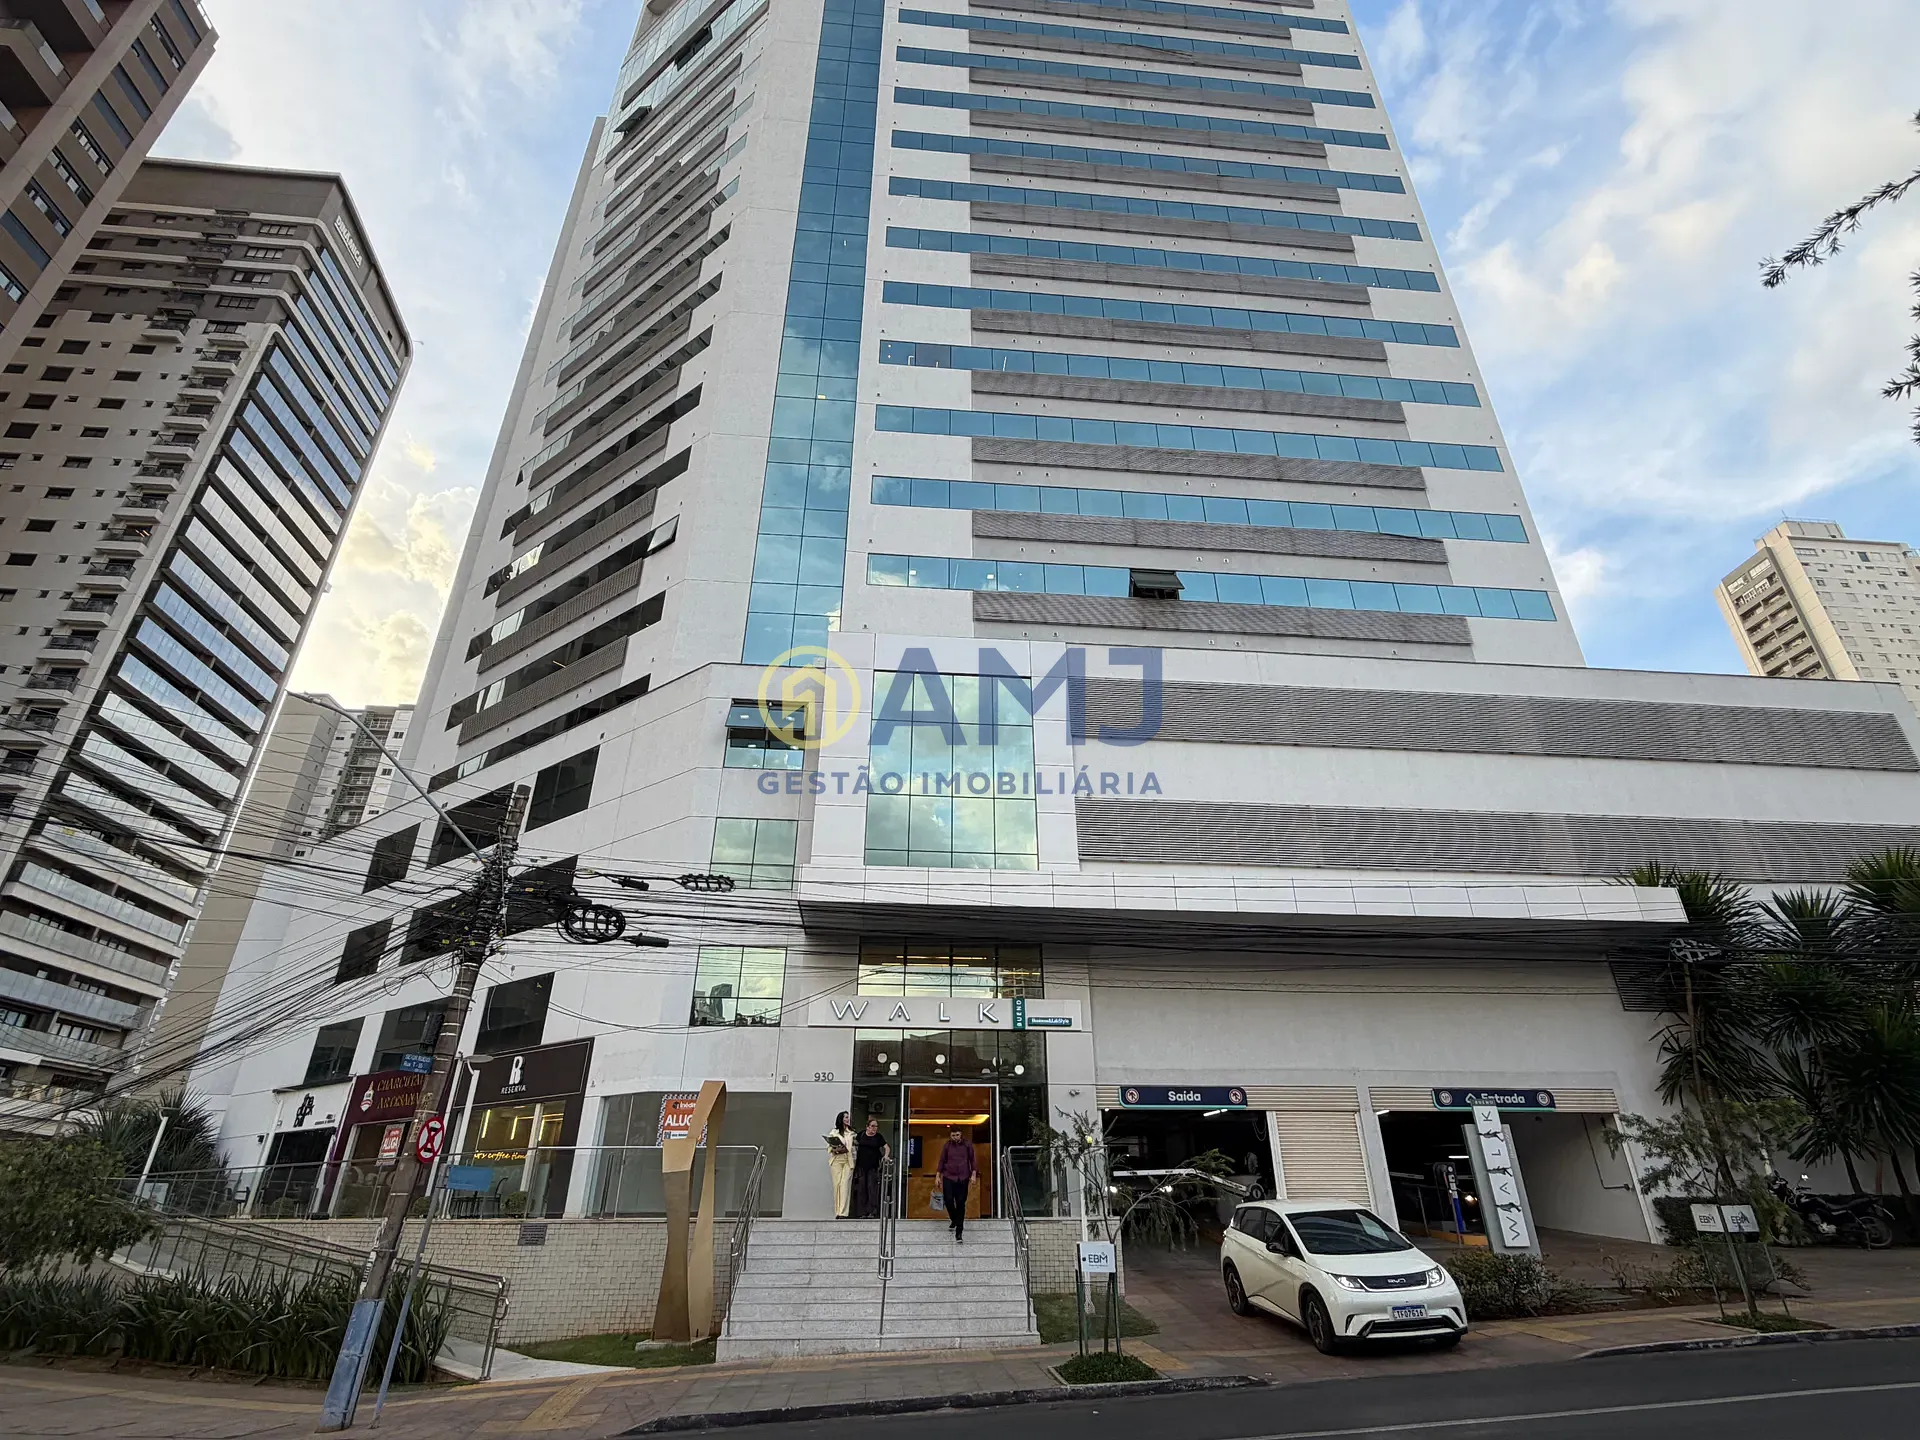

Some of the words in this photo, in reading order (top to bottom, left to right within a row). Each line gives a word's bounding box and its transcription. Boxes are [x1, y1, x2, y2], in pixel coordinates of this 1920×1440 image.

[831, 1000, 999, 1023] WALK
[814, 1071, 835, 1082] 930
[501, 1085, 527, 1095] RESERVA
[1167, 1090, 1202, 1102] Saída
[1088, 1254, 1108, 1264] EBM
